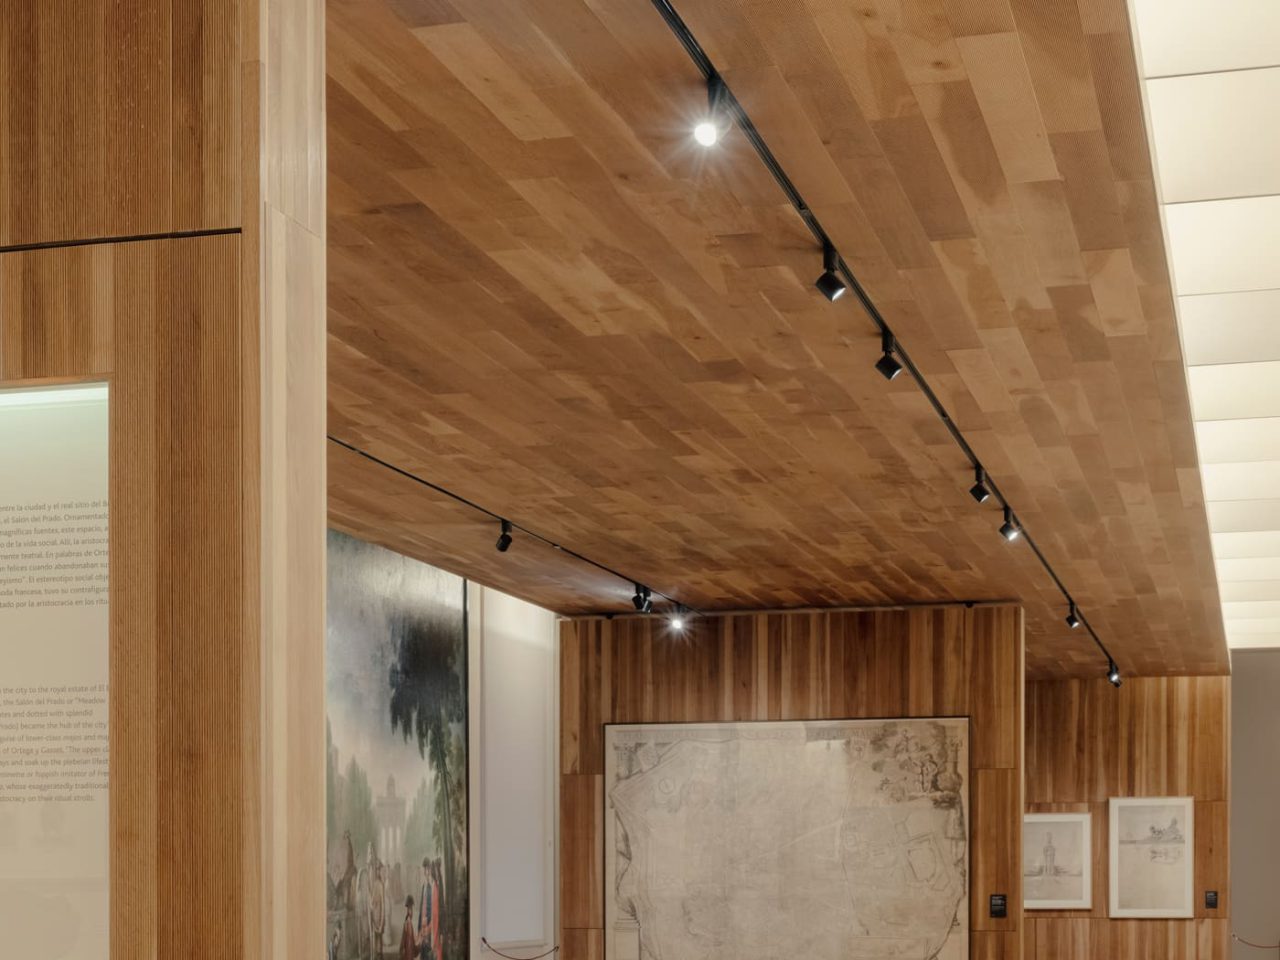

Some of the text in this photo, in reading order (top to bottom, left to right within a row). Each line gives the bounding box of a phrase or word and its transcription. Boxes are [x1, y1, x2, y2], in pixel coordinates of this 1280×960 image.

[48, 504, 52, 512] y
[53, 502, 59, 510] el
[91, 499, 101, 508] del
[4, 516, 10, 524] el
[31, 515, 41, 523] del
[55, 549, 82, 560] palabras
[84, 549, 92, 557] de
[54, 560, 99, 570] abandonaban
[36, 574, 74, 585] estereotipo
[45, 587, 59, 595] tuvo
[16, 602, 27, 610] por
[3, 698, 14, 706] the
[82, 720, 93, 728] the
[84, 733, 96, 741] and
